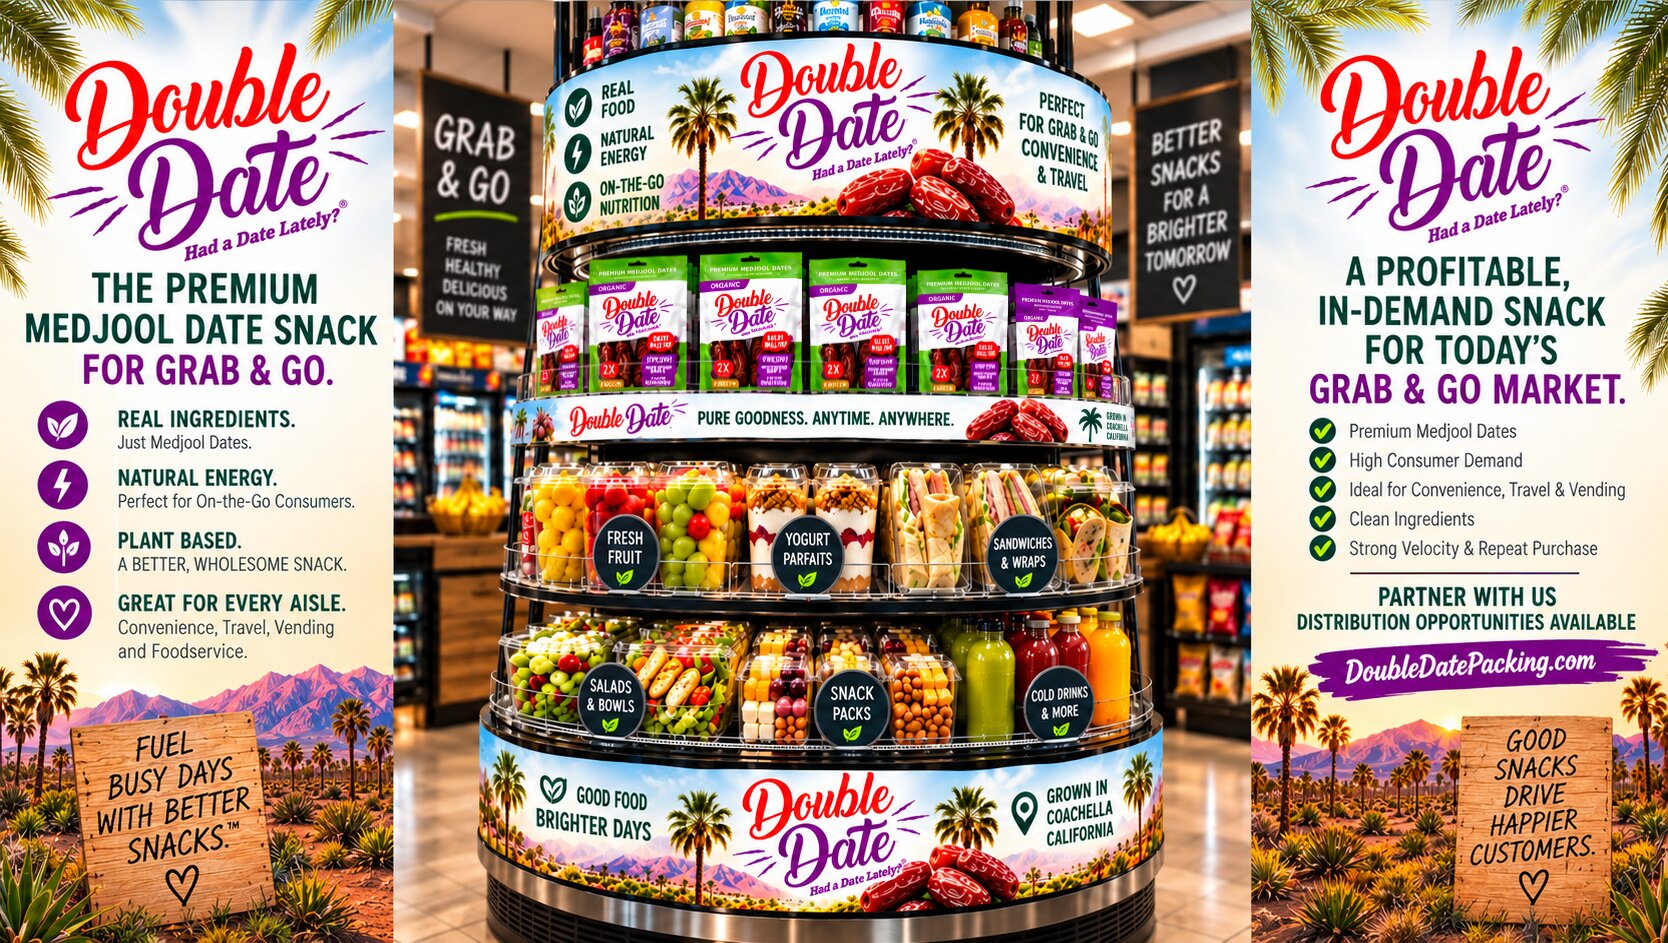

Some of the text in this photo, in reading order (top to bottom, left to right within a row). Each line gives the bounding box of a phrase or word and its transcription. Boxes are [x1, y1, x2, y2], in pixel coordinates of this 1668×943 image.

[602, 80, 634, 100] REAL
[740, 41, 902, 119] Double
[65, 43, 329, 171] Double
[602, 98, 635, 118] FOOD
[1039, 92, 1085, 119] PERFECT
[1320, 46, 1550, 160] Double
[434, 114, 515, 160] GRAB
[601, 125, 654, 146] NATURAL
[778, 93, 905, 169] Date
[1019, 113, 1098, 147] FOR GRAB & GO
[1152, 118, 1222, 156] BETTER
[601, 145, 647, 166] ENERGY
[1022, 138, 1098, 172] CONVENIENCE
[1150, 151, 1221, 186] SNACKS
[1379, 122, 1551, 231] Date
[128, 130, 329, 251] Date
[437, 160, 510, 205] & GO
[600, 173, 664, 195] ON-THE-GO
[600, 195, 659, 216] NUTRITION
[1147, 210, 1228, 244] BRIGHTER
[184, 241, 218, 262] Had
[223, 240, 233, 252] a
[237, 228, 275, 247] Date
[446, 236, 487, 256] FRESH
[1144, 239, 1231, 272] TOMORROW
[445, 258, 501, 279] HEALTHY
[1345, 257, 1570, 291] A PROFITABLE,
[92, 273, 317, 304] THE PREMIUM
[442, 278, 507, 301] DELICIOUS
[598, 284, 626, 292] ORGANIC
[436, 300, 517, 322] ON YOUR WAY
[603, 291, 659, 320] Double
[715, 289, 774, 318] Double
[1319, 296, 1605, 326] IN-DEMAND SNACK
[25, 314, 377, 345] MEDJOOL DATE SNACK
[615, 308, 661, 336] Date
[728, 305, 776, 335] Date
[1366, 335, 1557, 364] FOR TODAY’S
[83, 354, 333, 385] FOR GRAB & GO.
[603, 365, 614, 374] 2X
[717, 363, 729, 372] 2X
[1310, 374, 1625, 404] GRAB & GO MARKET.
[118, 410, 295, 428] REAL INGREDIENTS.
[570, 402, 674, 436] Double Date
[698, 411, 954, 426] PURE GOODNESS. ANYTIME. ANYWHERE.
[118, 435, 251, 452] Just Medjool Dates.
[1350, 424, 1517, 441] Premium Medjool Dates
[1350, 453, 1522, 471] High Consumer Demand
[118, 469, 277, 486] NATURAL ENERGY.
[118, 494, 355, 508] Perfect for On-the-Go Consumers.
[1350, 482, 1626, 500] Ideal for Convenience, Travel & Vending
[118, 532, 241, 549] PLANT BASED.
[607, 531, 643, 545] FRESH
[785, 532, 830, 546] YOGURT
[993, 536, 1052, 551] SANDWICHES
[118, 557, 347, 574] A BETTER, WHOLESOME SNACK.
[608, 550, 642, 565] FRUIT
[783, 552, 832, 566] PARFAITS
[1001, 555, 1046, 569] & WRAPS
[118, 594, 346, 612] GREAT FOR EVERY AISLE.
[1379, 587, 1556, 606] PARTNER WITH US
[118, 620, 334, 638] Convenience, Travel, Vending
[1298, 614, 1636, 630] DISTRIBUTION OPPORTUNITIES AVAILABLE
[1345, 650, 1596, 685] DoubleDatePacking.com
[590, 678, 632, 694] SALADS
[830, 686, 874, 700] SNACK
[1031, 685, 1088, 703] COLD DRINKS
[586, 698, 635, 713] & BOWLS
[833, 706, 871, 721] PACKS
[1041, 704, 1079, 719] & MORE
[136, 730, 193, 762] FUEL
[1507, 728, 1566, 752] GOOD
[108, 756, 233, 800] BUSY DAYS
[1495, 755, 1578, 780] SNACKS
[576, 785, 647, 810] GOOD FOOD
[1046, 778, 1107, 805] GROWN IN
[1504, 783, 1566, 808] DRIVE
[97, 787, 250, 835] WITH BETTER
[742, 771, 894, 840] Double
[1046, 800, 1113, 826] COACHELLA
[536, 808, 651, 841] BRIGHTER DAYS
[1046, 823, 1114, 847] CALIFORNIA
[1490, 809, 1577, 836] HAPPIER
[778, 818, 896, 888] Date
[1470, 835, 1595, 866] CUSTOMERS.
